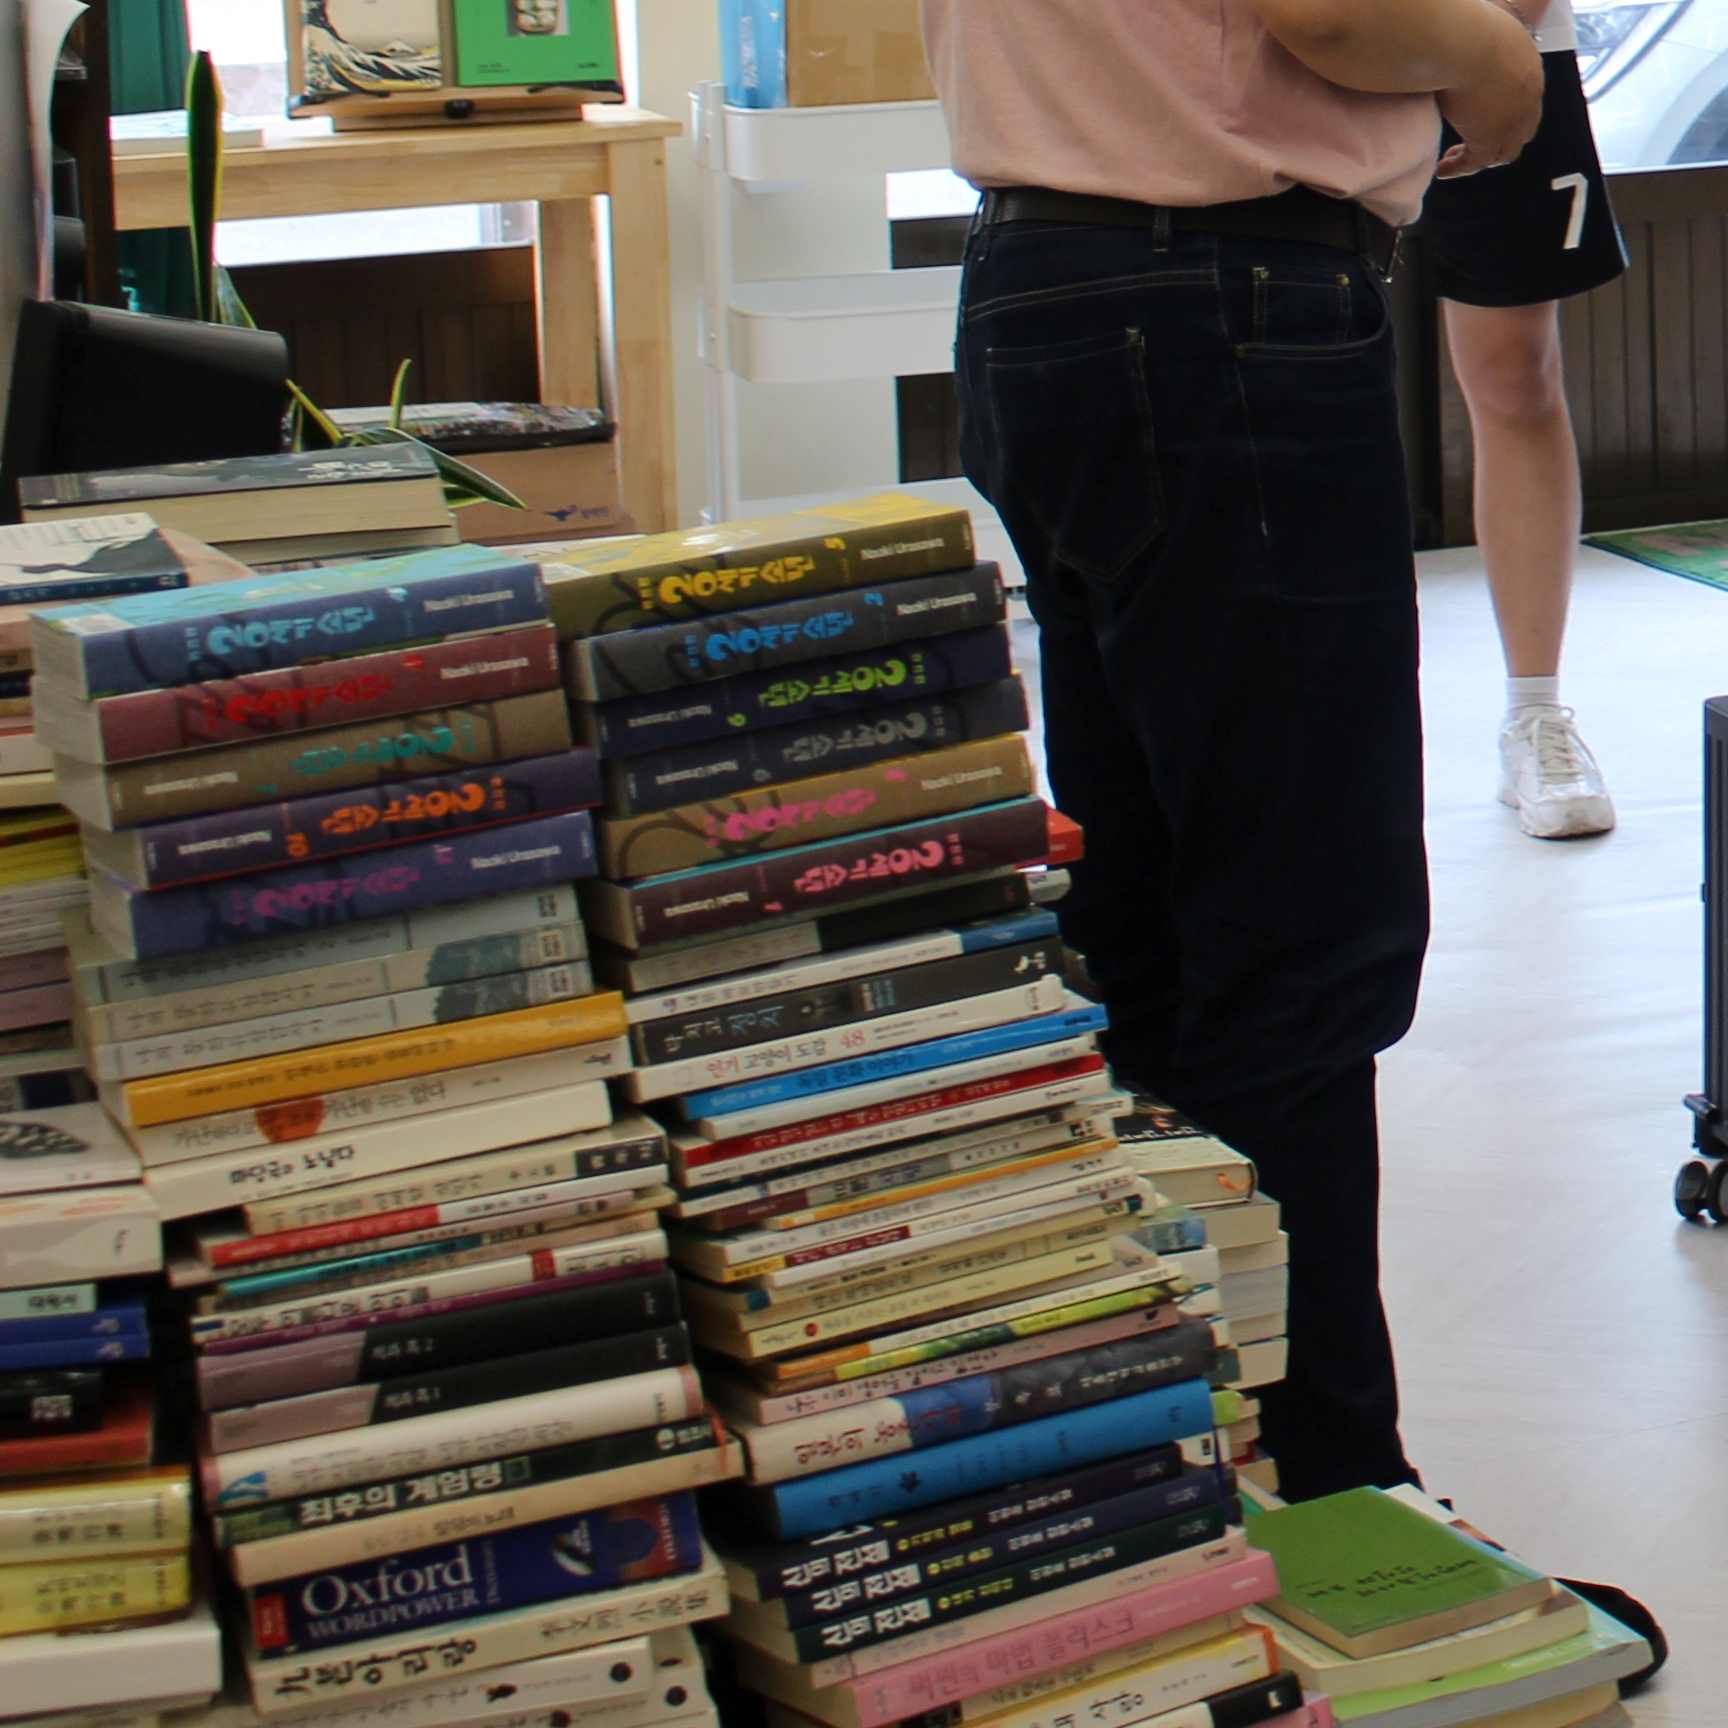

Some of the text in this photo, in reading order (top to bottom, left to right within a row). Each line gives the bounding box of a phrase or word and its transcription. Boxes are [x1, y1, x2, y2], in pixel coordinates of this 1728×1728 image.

[1550, 174, 1589, 250] 7
[838, 1027, 868, 1051] 48
[295, 1482, 398, 1529] 최후의
[405, 1459, 505, 1506] 계엄령
[296, 1541, 476, 1621] Oxford
[306, 1584, 483, 1646] WORDPOWER
